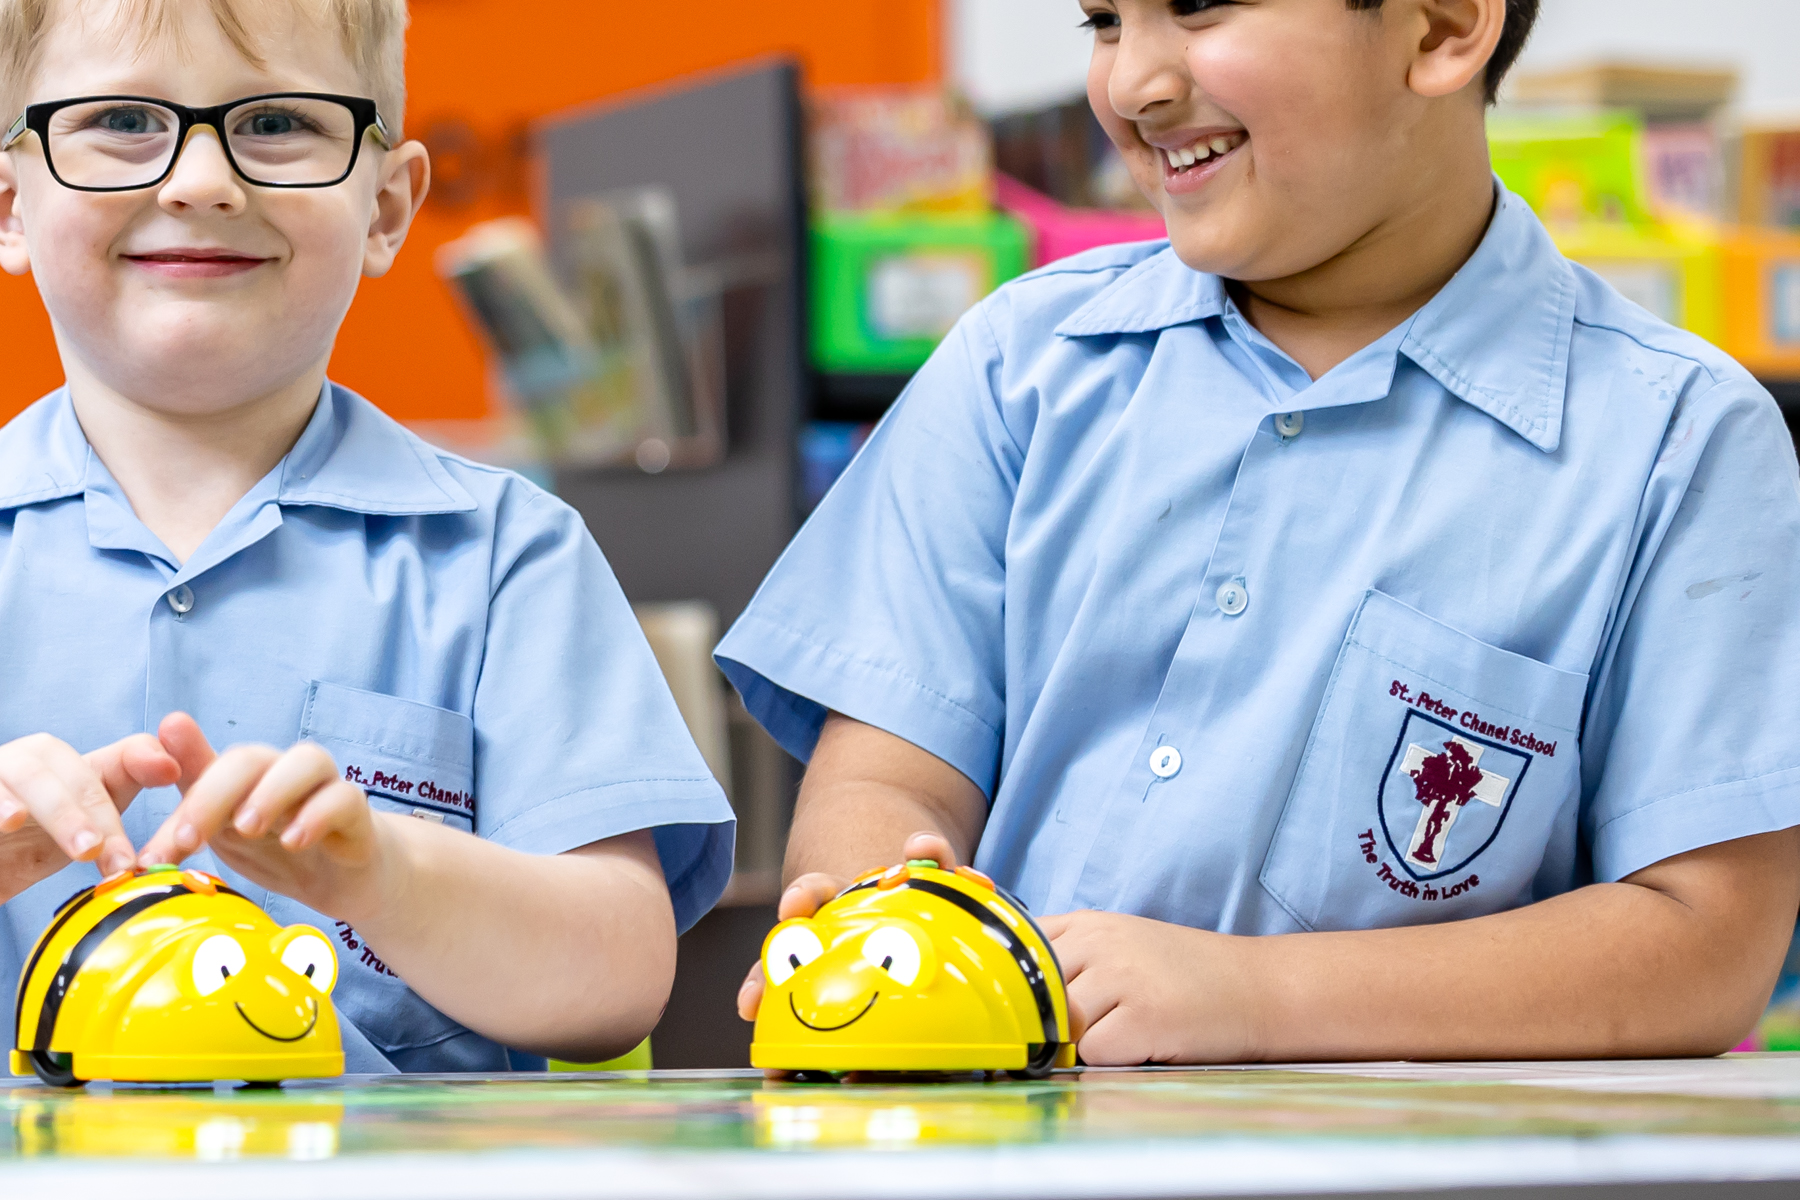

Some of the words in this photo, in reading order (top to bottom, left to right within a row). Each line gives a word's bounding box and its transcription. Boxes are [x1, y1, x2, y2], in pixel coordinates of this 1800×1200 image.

[1389, 679, 1414, 704] St.
[1416, 691, 1458, 722] Peter
[1459, 710, 1509, 743] Chanel
[1509, 728, 1558, 758] School
[345, 764, 368, 784] St.
[373, 770, 414, 794] Peter
[417, 780, 463, 806] Chanel
[1357, 828, 1378, 865] The
[1375, 862, 1420, 900] Truth
[1422, 883, 1439, 901] in
[1441, 873, 1481, 901] Love
[360, 946, 399, 978] Tru
